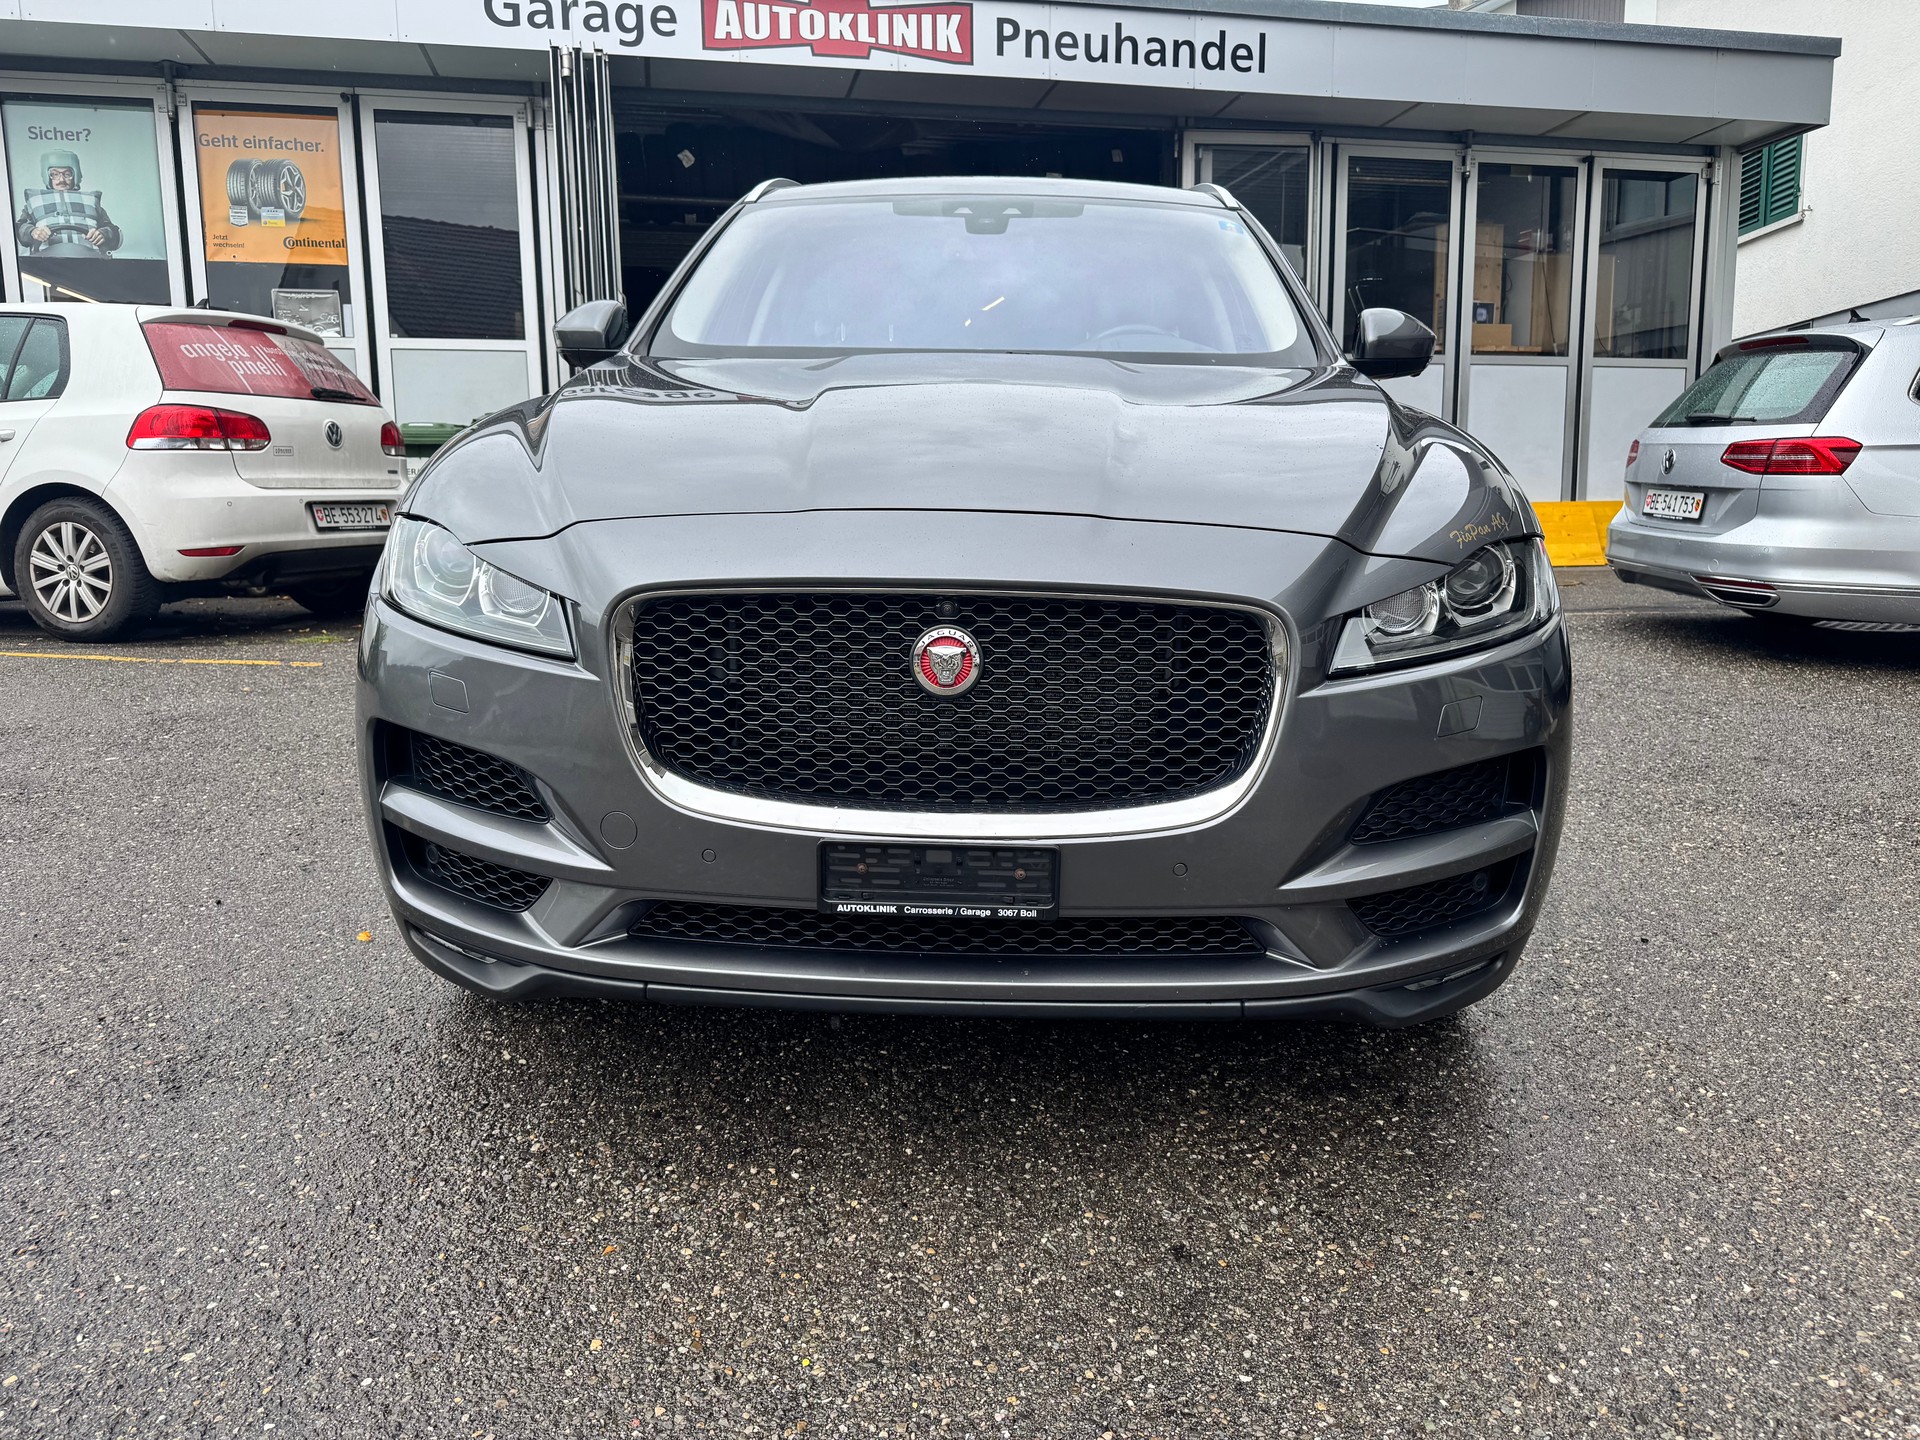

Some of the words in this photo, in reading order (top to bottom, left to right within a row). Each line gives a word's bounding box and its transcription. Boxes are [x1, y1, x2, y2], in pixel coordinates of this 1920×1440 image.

[484, 0, 678, 47] Garage
[714, 0, 963, 54] AUTOKLINIK
[996, 17, 1266, 73] Pneuhandel
[27, 126, 91, 142] Sicher?
[199, 133, 238, 148] Geht
[243, 135, 324, 152] einfacher.
[283, 236, 345, 249] Continental
[180, 342, 250, 361] angela
[228, 346, 287, 377] pinelli
[920, 629, 974, 648] JAGUAR
[837, 904, 897, 913] AUTOKLINIK
[904, 906, 953, 915] Carrosserie
[960, 907, 991, 917] Garage
[997, 909, 1018, 917] 3067
